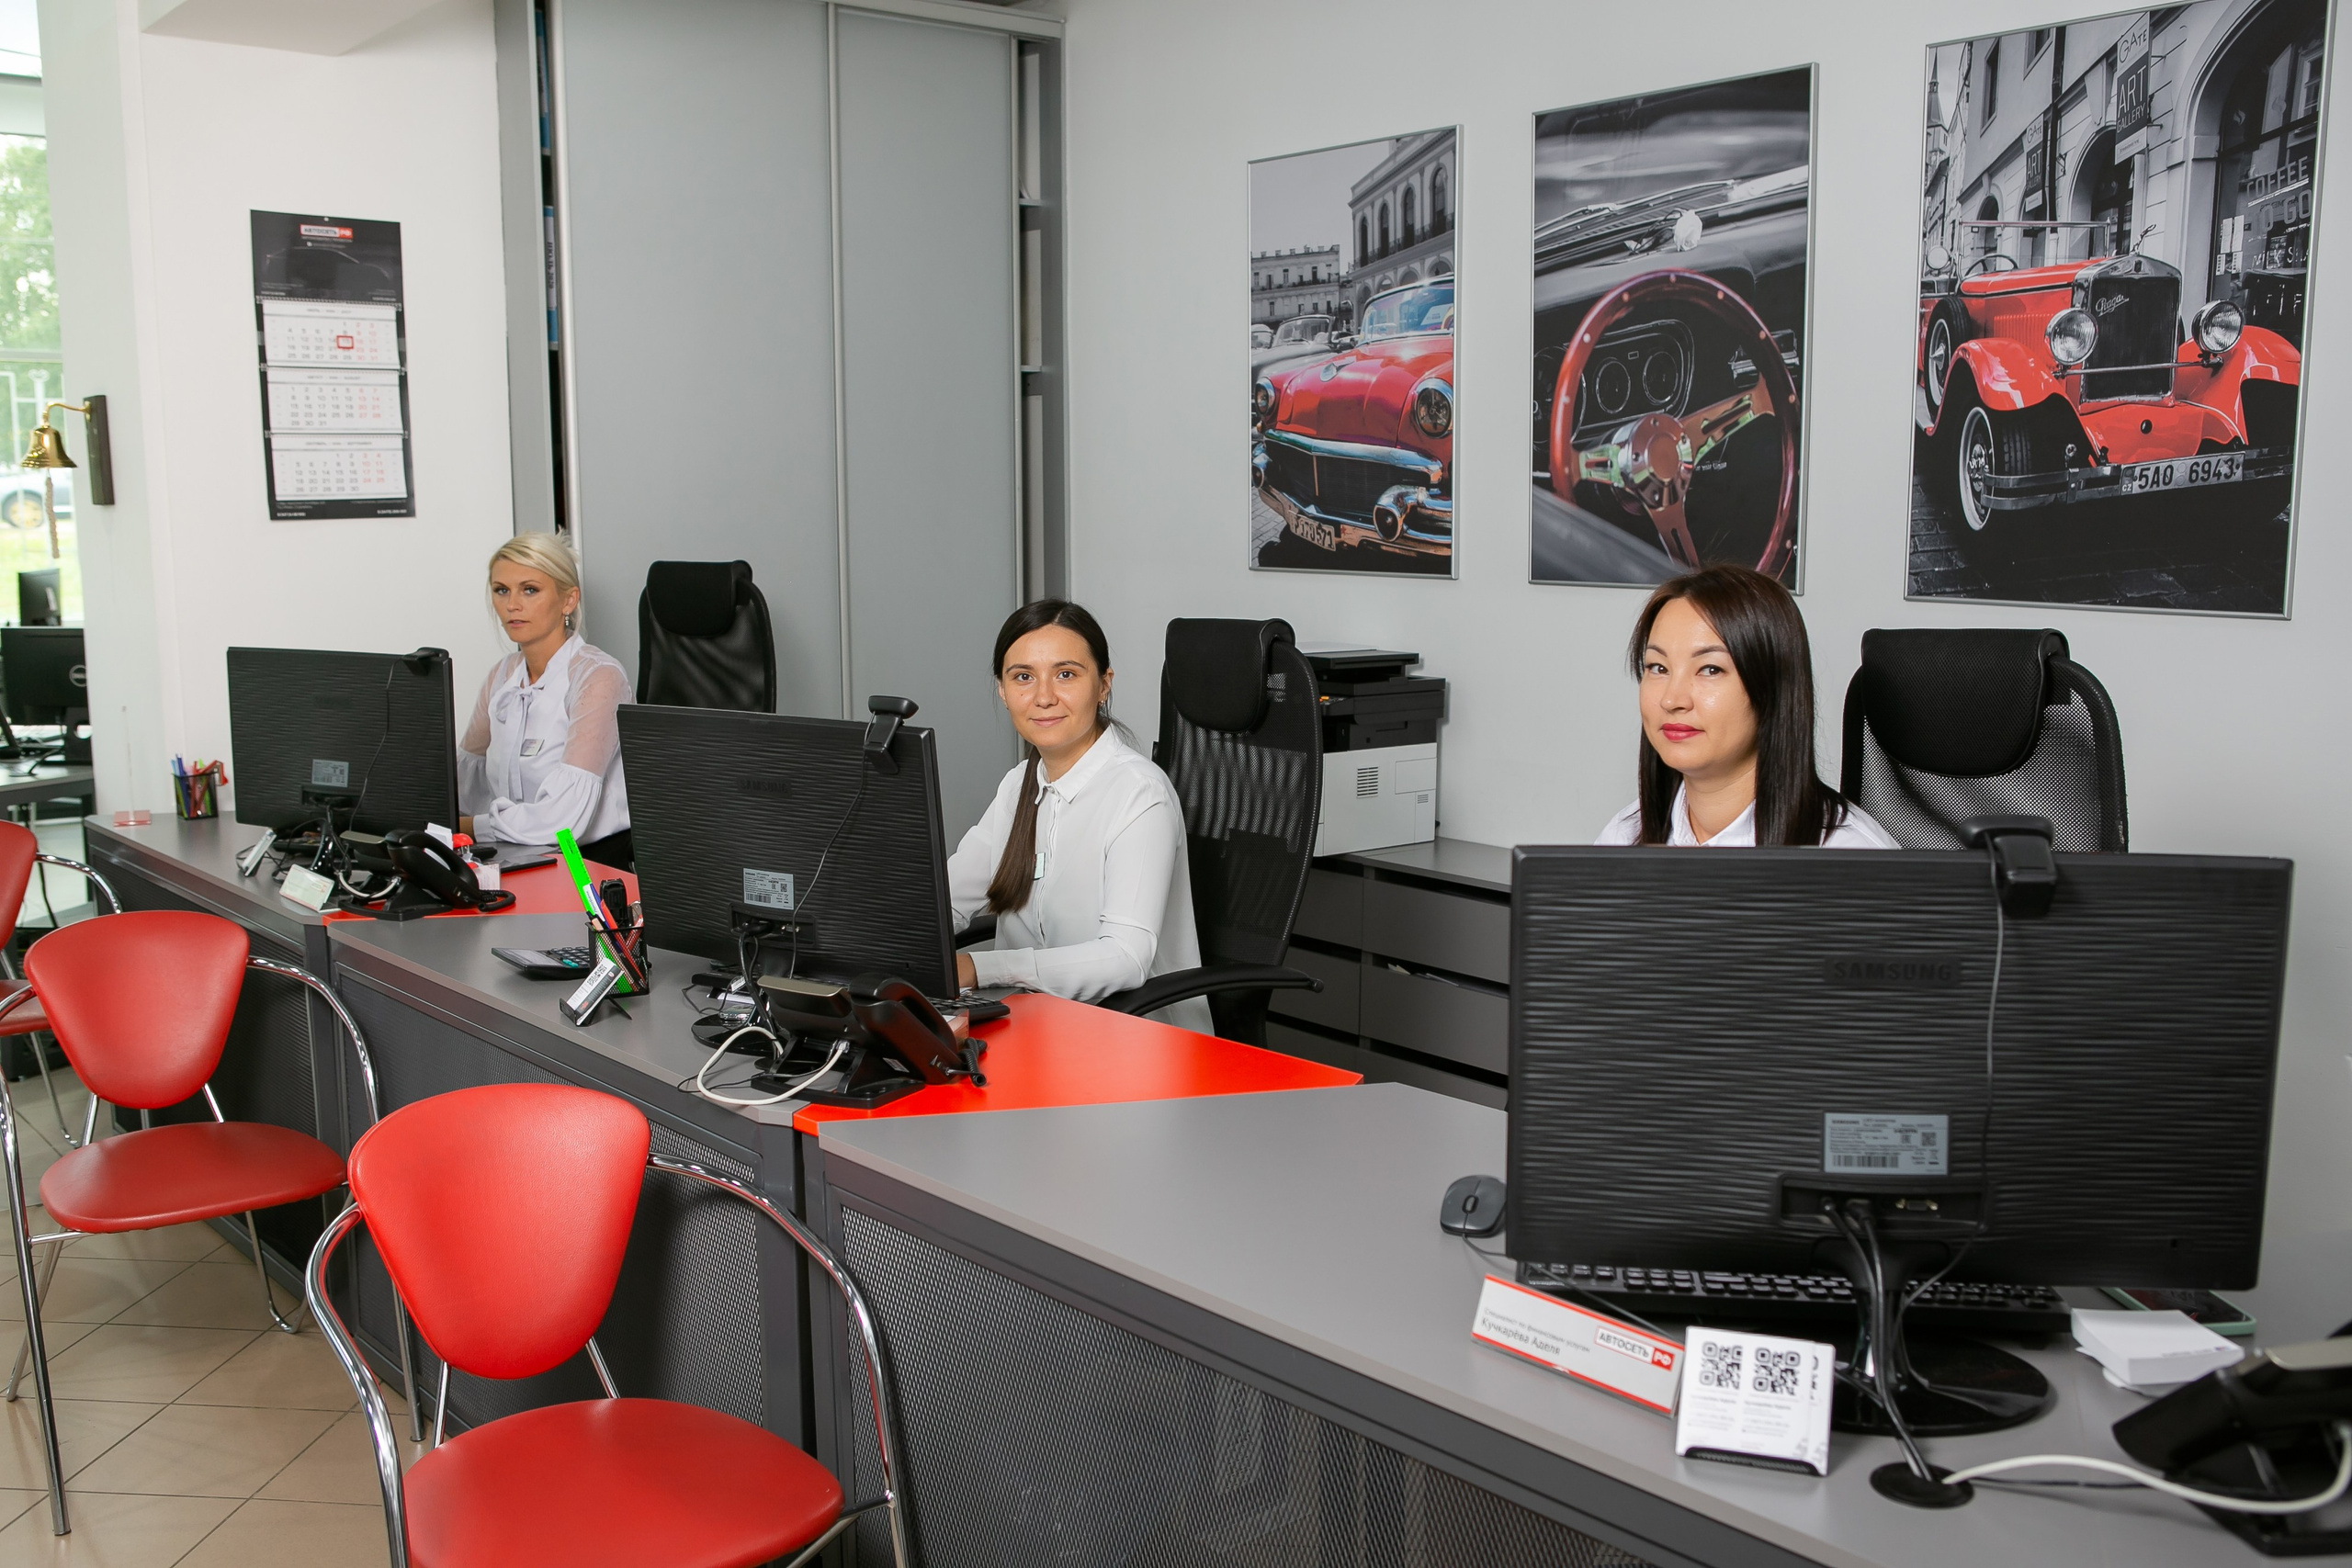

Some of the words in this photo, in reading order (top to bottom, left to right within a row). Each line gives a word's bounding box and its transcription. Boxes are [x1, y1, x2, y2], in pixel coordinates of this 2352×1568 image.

[2120, 29, 2148, 63] GATE
[2118, 64, 2147, 118] ART
[2117, 102, 2146, 133] GALLERY
[2027, 149, 2042, 180] ART
[2246, 155, 2309, 198] COFFEE
[2283, 188, 2312, 225] GO
[2188, 458, 2234, 484] 6943
[2122, 483, 2132, 492] CZ
[740, 778, 789, 794] SAMSUNG
[1833, 962, 1951, 981] SAMSUNG
[1482, 1317, 1530, 1343] Кучкарёва
[1532, 1336, 1560, 1355] Аделя
[1599, 1332, 1649, 1358] АВТОСЕТЬ
[1654, 1351, 1672, 1366] РФ
